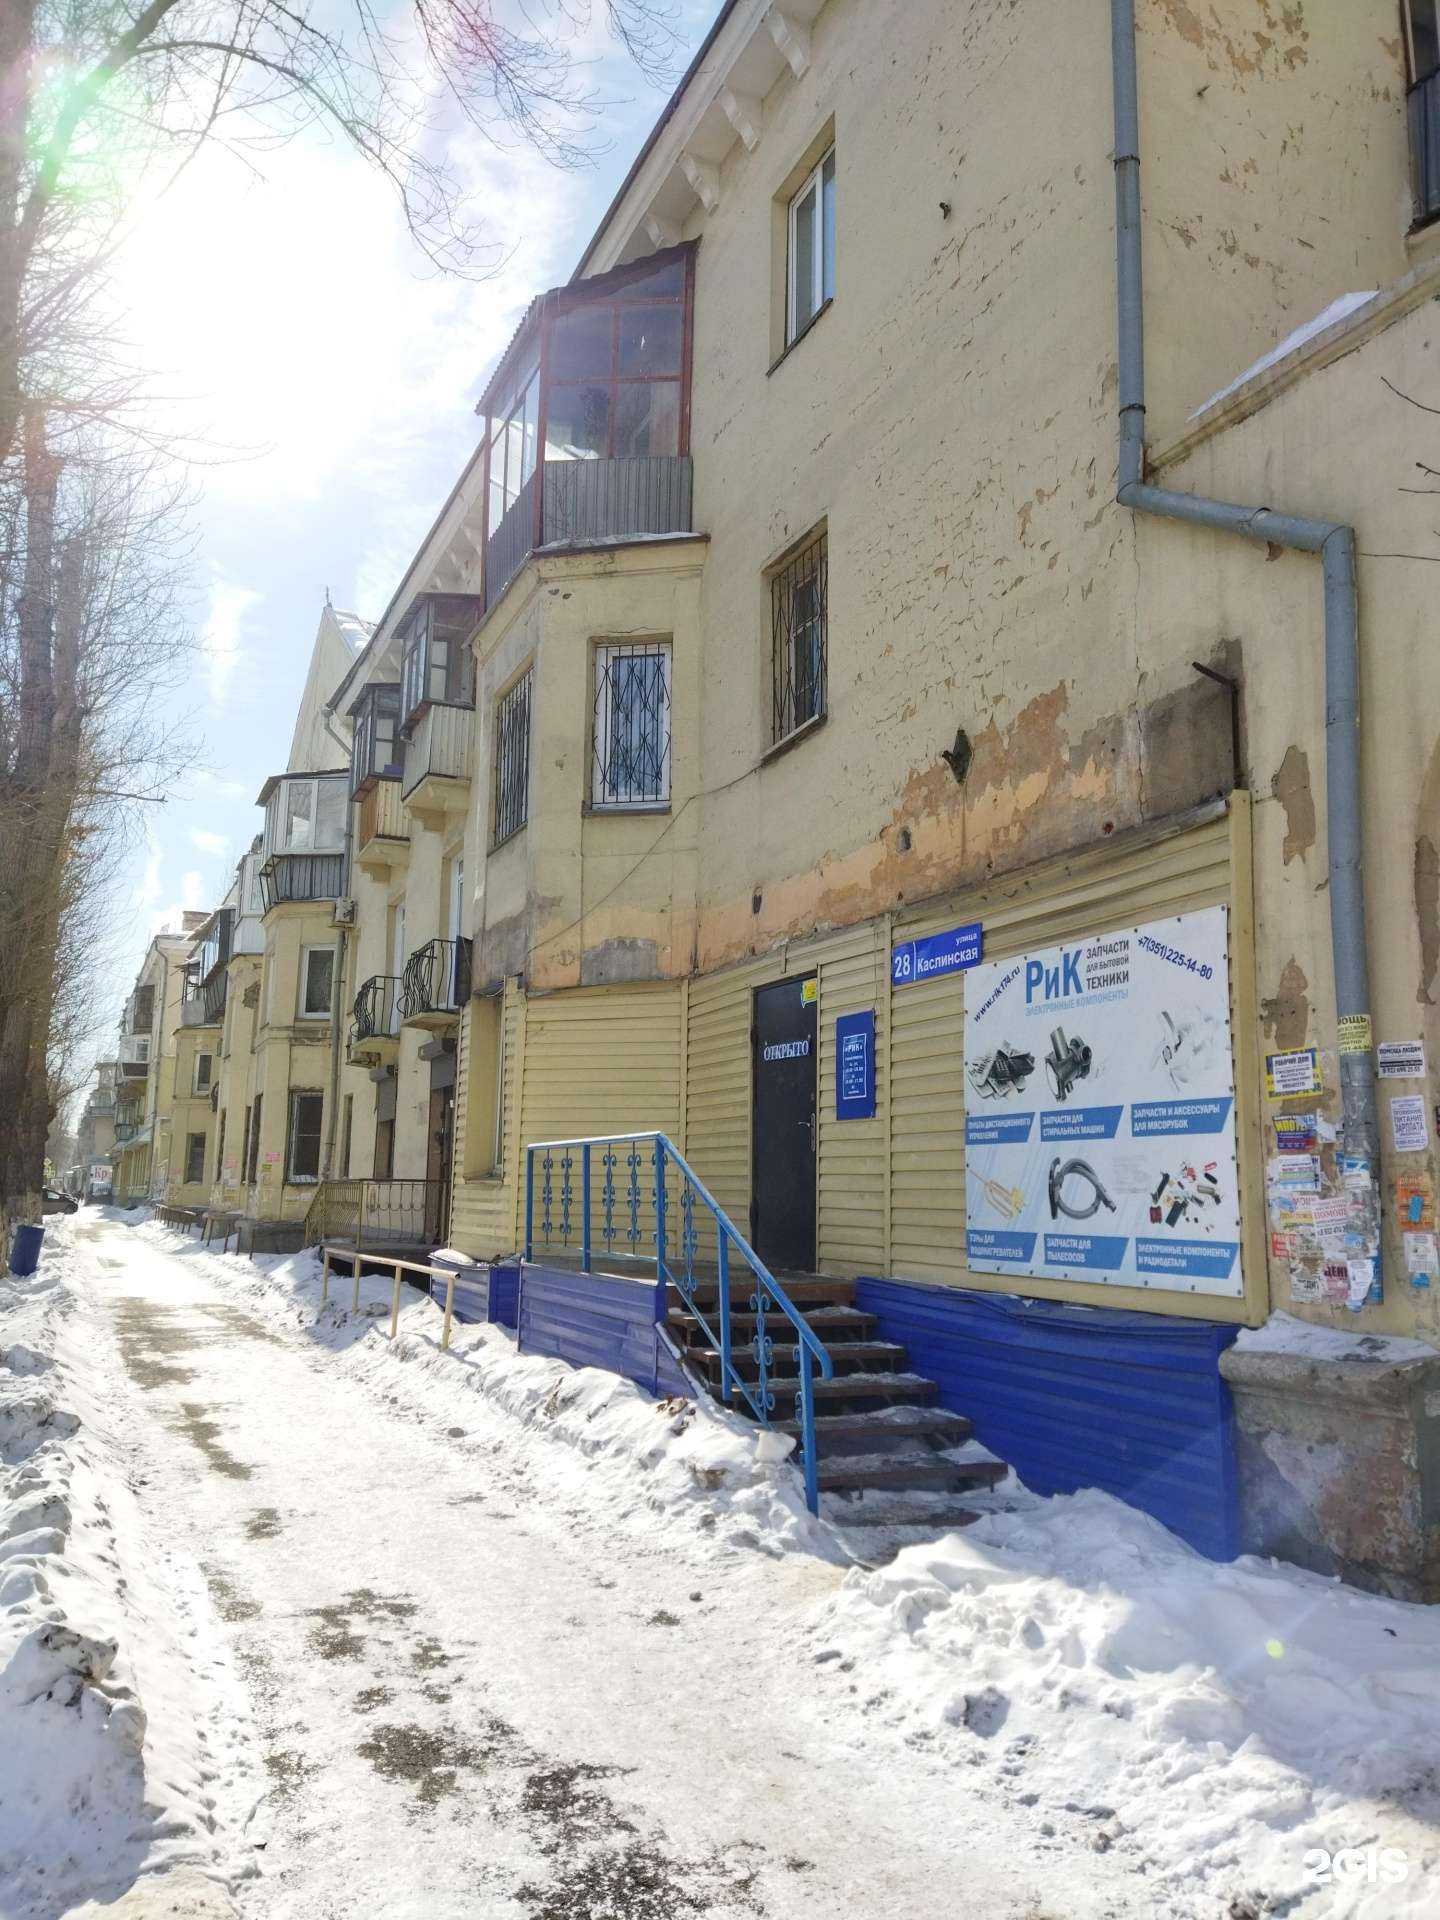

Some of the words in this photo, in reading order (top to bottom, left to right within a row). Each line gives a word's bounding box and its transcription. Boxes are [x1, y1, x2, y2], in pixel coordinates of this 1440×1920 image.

[955, 933, 977, 946] улица
[1086, 940, 1129, 959] ЗАПЧАСТИ
[894, 954, 911, 977] 28
[917, 947, 978, 973] Каслинская
[1086, 961, 1098, 973] ДЛЯ
[1099, 956, 1129, 970] БЫТОВОЙ
[1025, 949, 1083, 1004] РиК
[1086, 971, 1129, 990] ТЕХНИКИ
[974, 966, 1020, 1022] www.rik174.ru
[1025, 999, 1075, 1016] ЭЛЕКТРОННЫЕ
[1076, 989, 1128, 1010] КОМПОНЕНТЫ
[764, 1040, 809, 1060] ОТКРЫТО
[1134, 1107, 1166, 1118] ЗАПЧАСТИ
[1174, 1102, 1220, 1116] АКСЕССУАРЫ
[1148, 1119, 1188, 1130] МЯСОРУБОК
